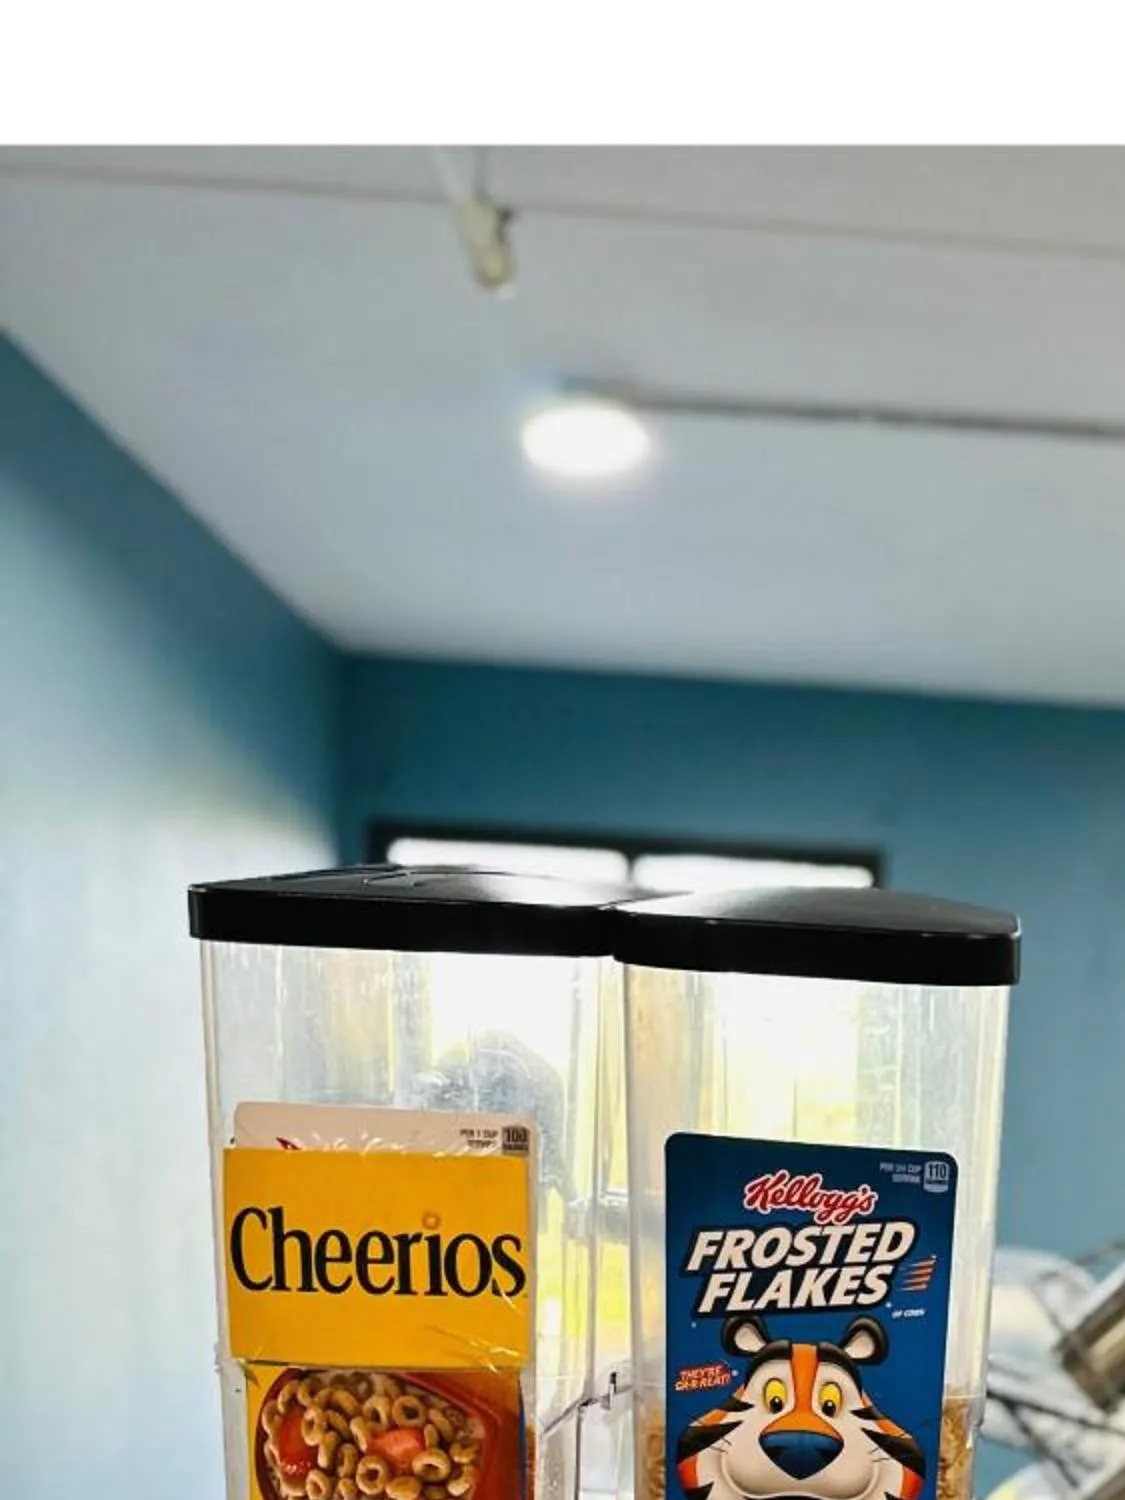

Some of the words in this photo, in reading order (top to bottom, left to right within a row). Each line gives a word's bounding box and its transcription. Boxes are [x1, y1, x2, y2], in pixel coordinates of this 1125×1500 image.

[928, 1163, 947, 1178] 110
[744, 1169, 879, 1225] Kellogg's
[230, 1205, 527, 1298] Cheerios
[685, 1221, 916, 1272] FROSTED
[698, 1264, 893, 1313] FLAKES
